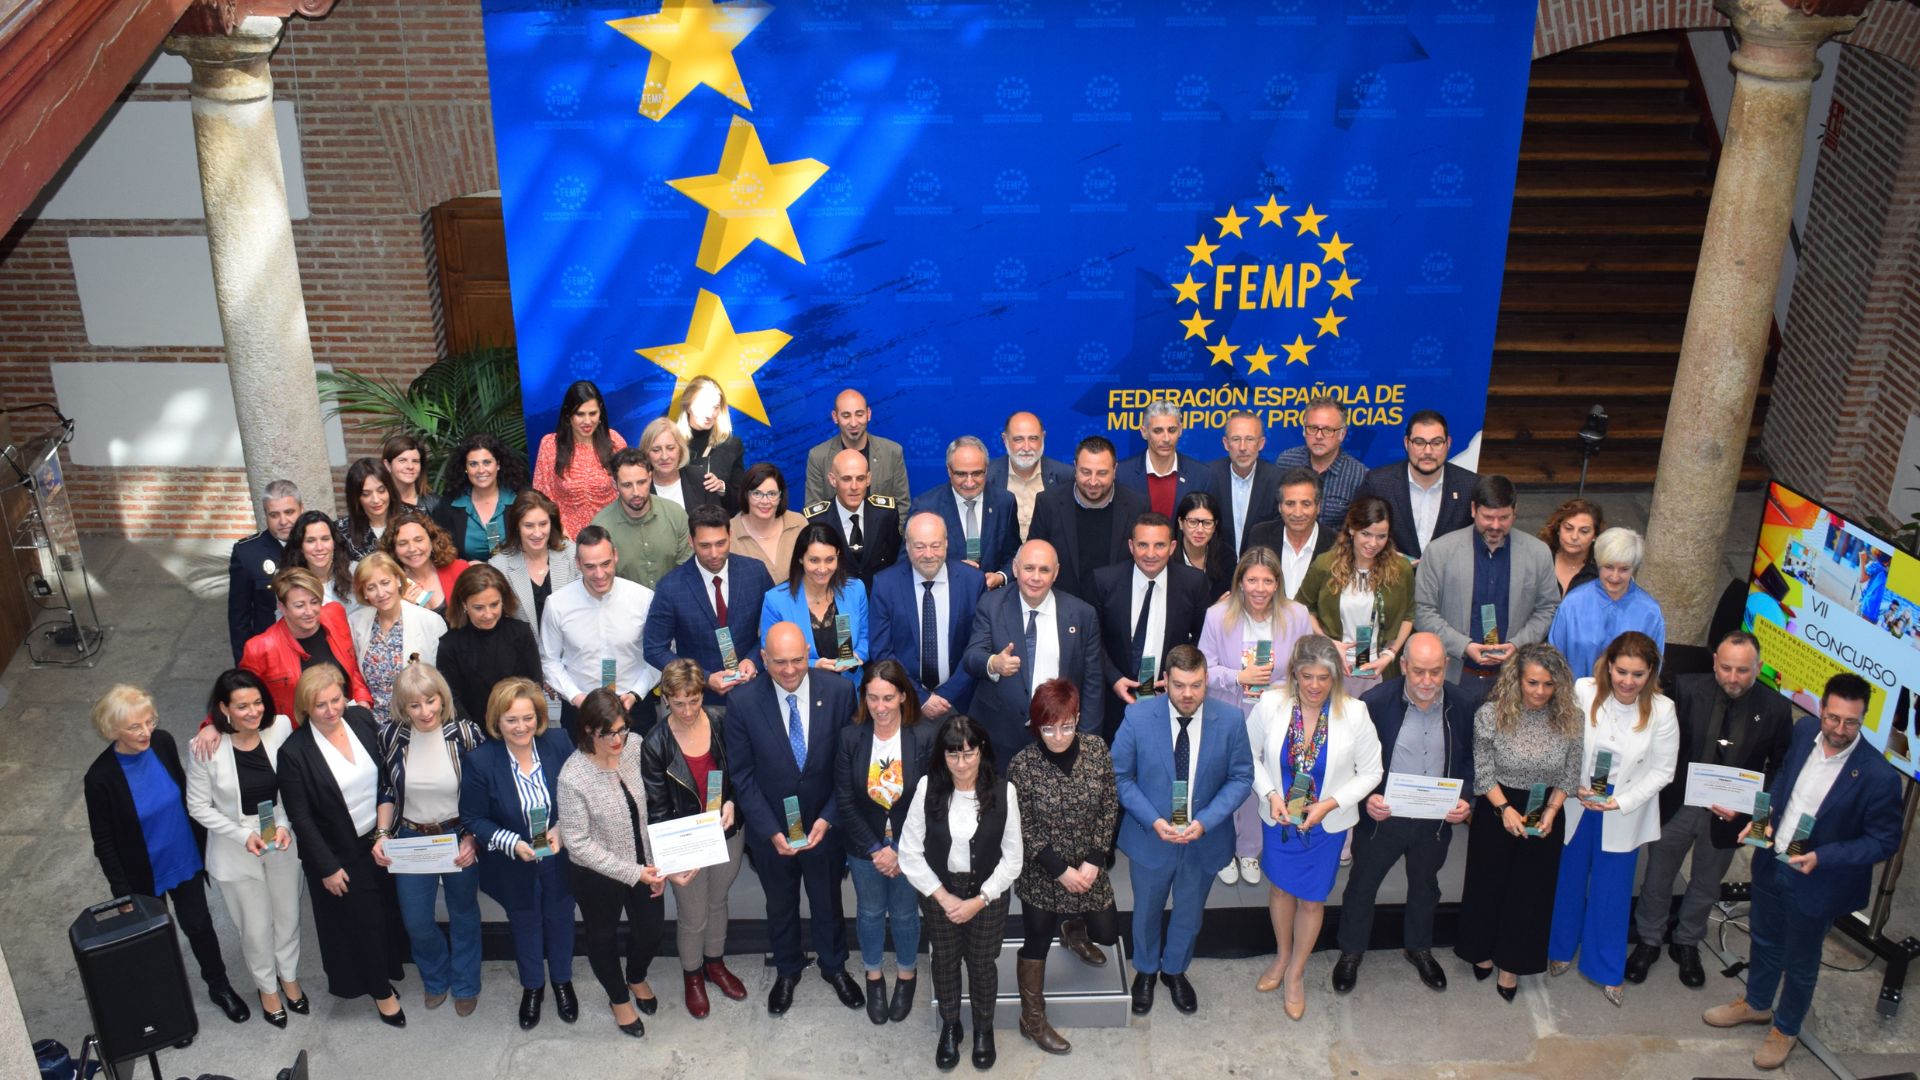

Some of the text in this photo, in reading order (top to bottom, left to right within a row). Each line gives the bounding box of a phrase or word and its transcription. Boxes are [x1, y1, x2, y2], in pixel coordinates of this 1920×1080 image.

[643, 94, 664, 104] FEMP
[1213, 262, 1322, 310] FEMP
[1375, 384, 1406, 404] DE
[1812, 596, 1828, 619] VII
[1760, 618, 1786, 638] BUENAS
[1804, 624, 1896, 687] CONCURSO
